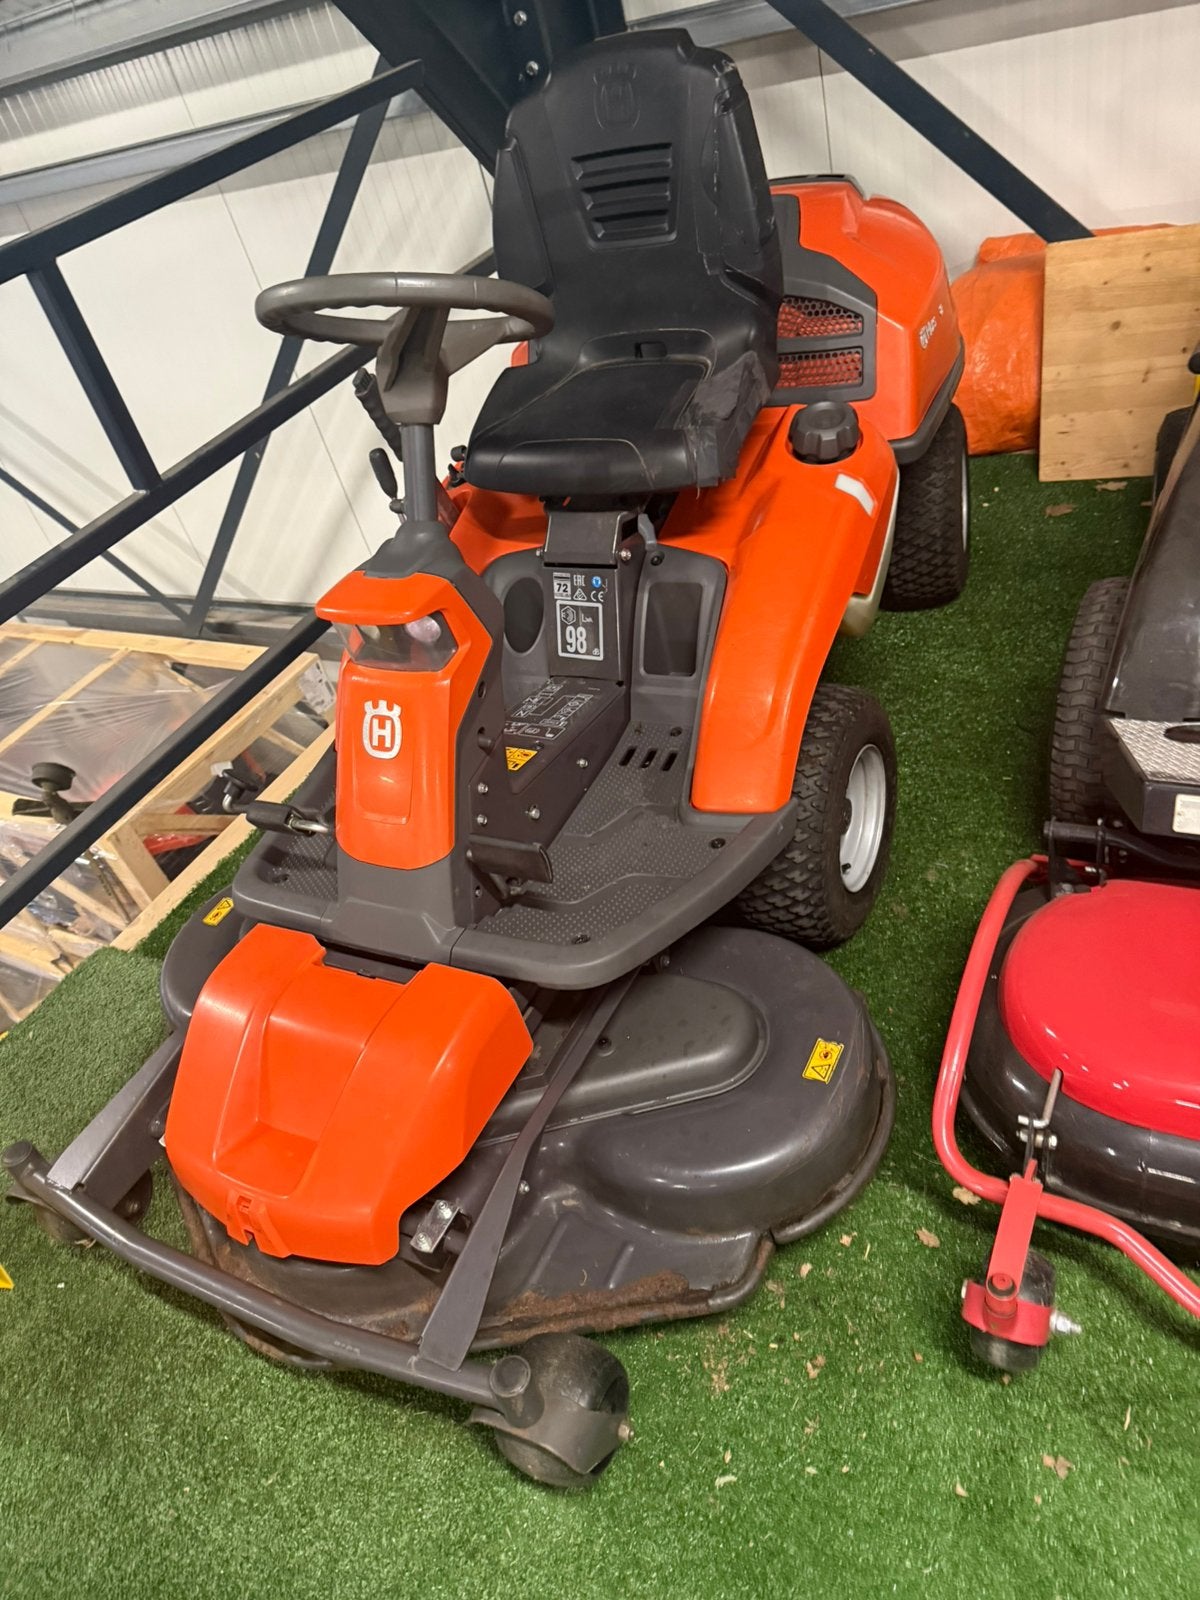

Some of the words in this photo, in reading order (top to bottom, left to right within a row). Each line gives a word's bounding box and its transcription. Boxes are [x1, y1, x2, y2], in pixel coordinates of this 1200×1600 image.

[556, 583, 568, 593] 72
[566, 626, 587, 653] 98
[372, 718, 392, 748] H
